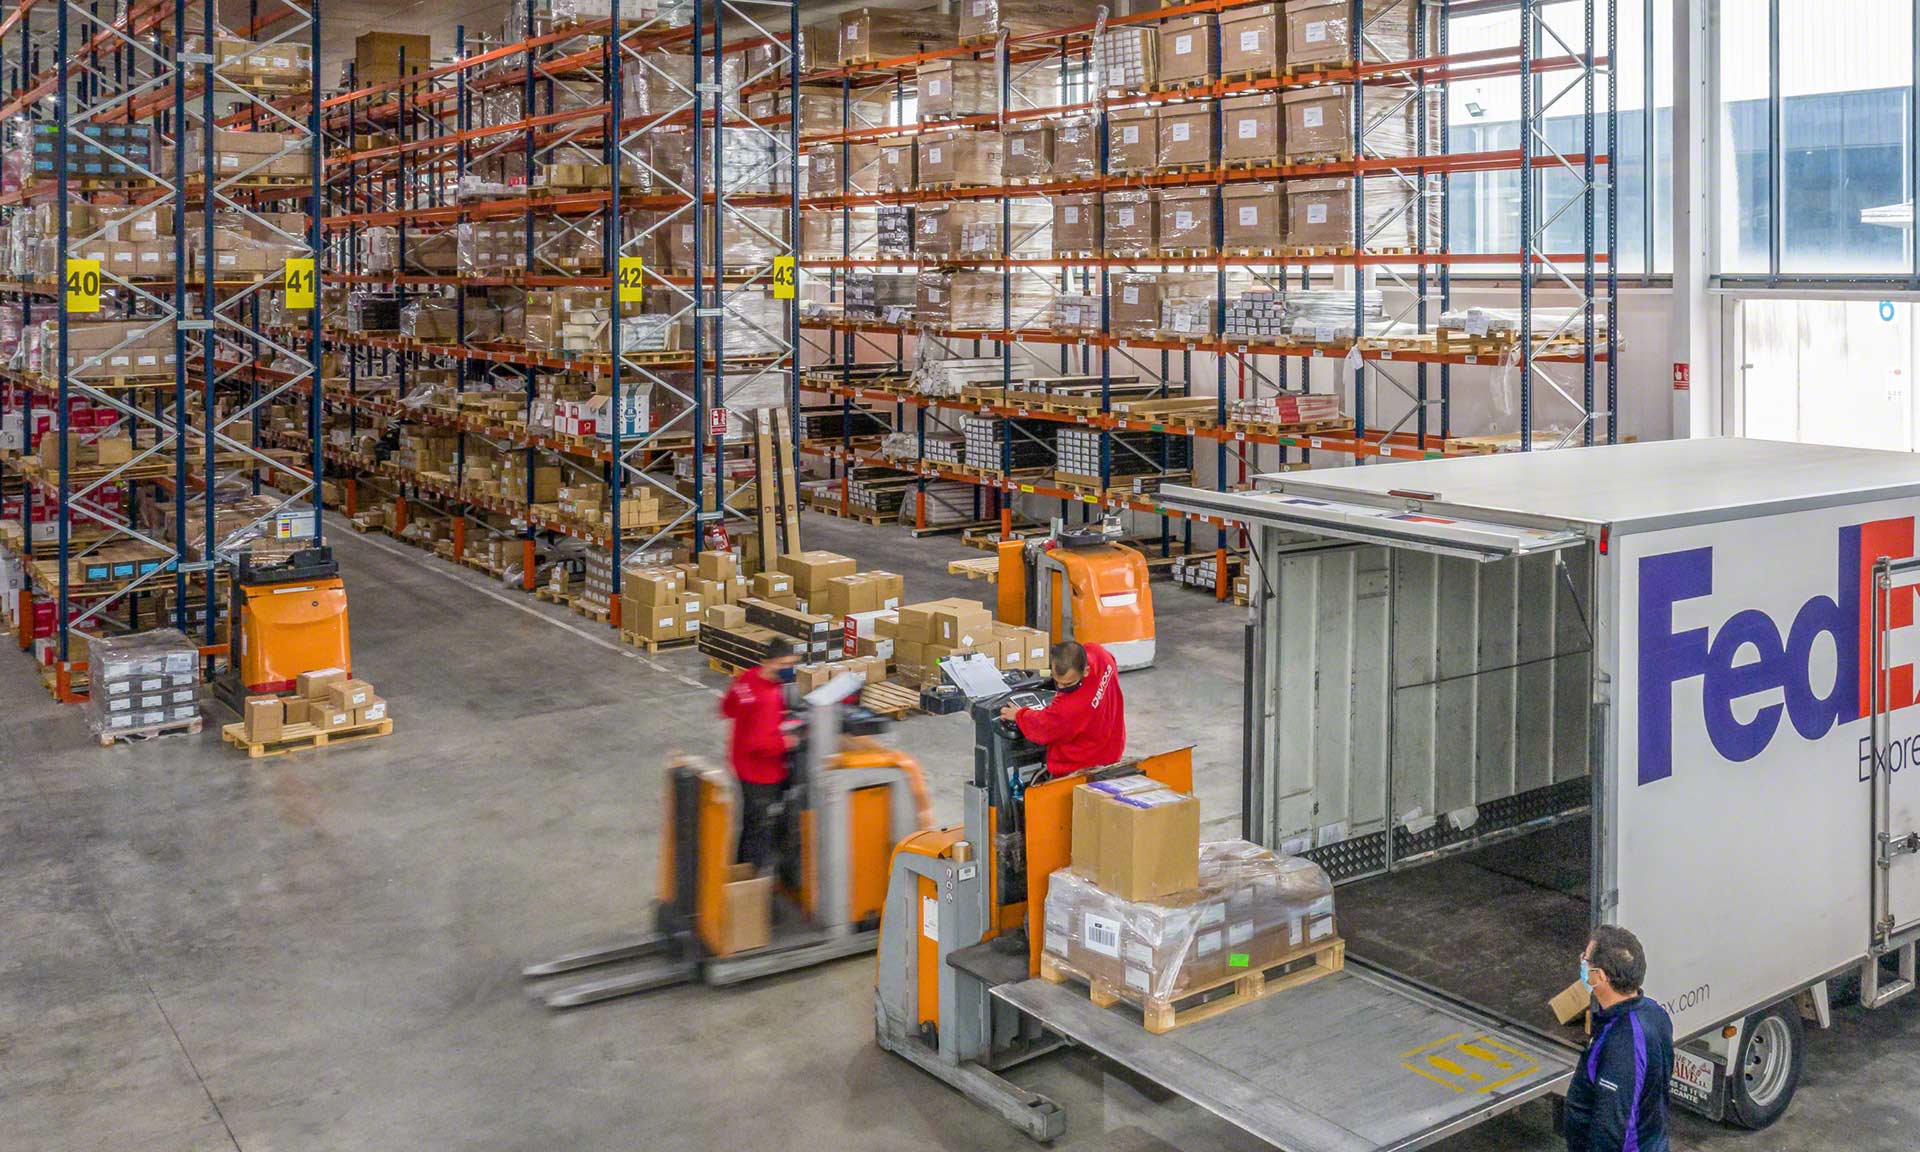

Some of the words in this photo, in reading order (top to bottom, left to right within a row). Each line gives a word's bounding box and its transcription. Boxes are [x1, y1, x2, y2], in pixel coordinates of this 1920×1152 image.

[66, 271, 98, 296] 40
[287, 270, 313, 293] 41
[619, 267, 641, 288] 42
[775, 266, 795, 286] 43
[1638, 516, 1920, 787] FedE
[1661, 984, 1710, 1015] x.com
